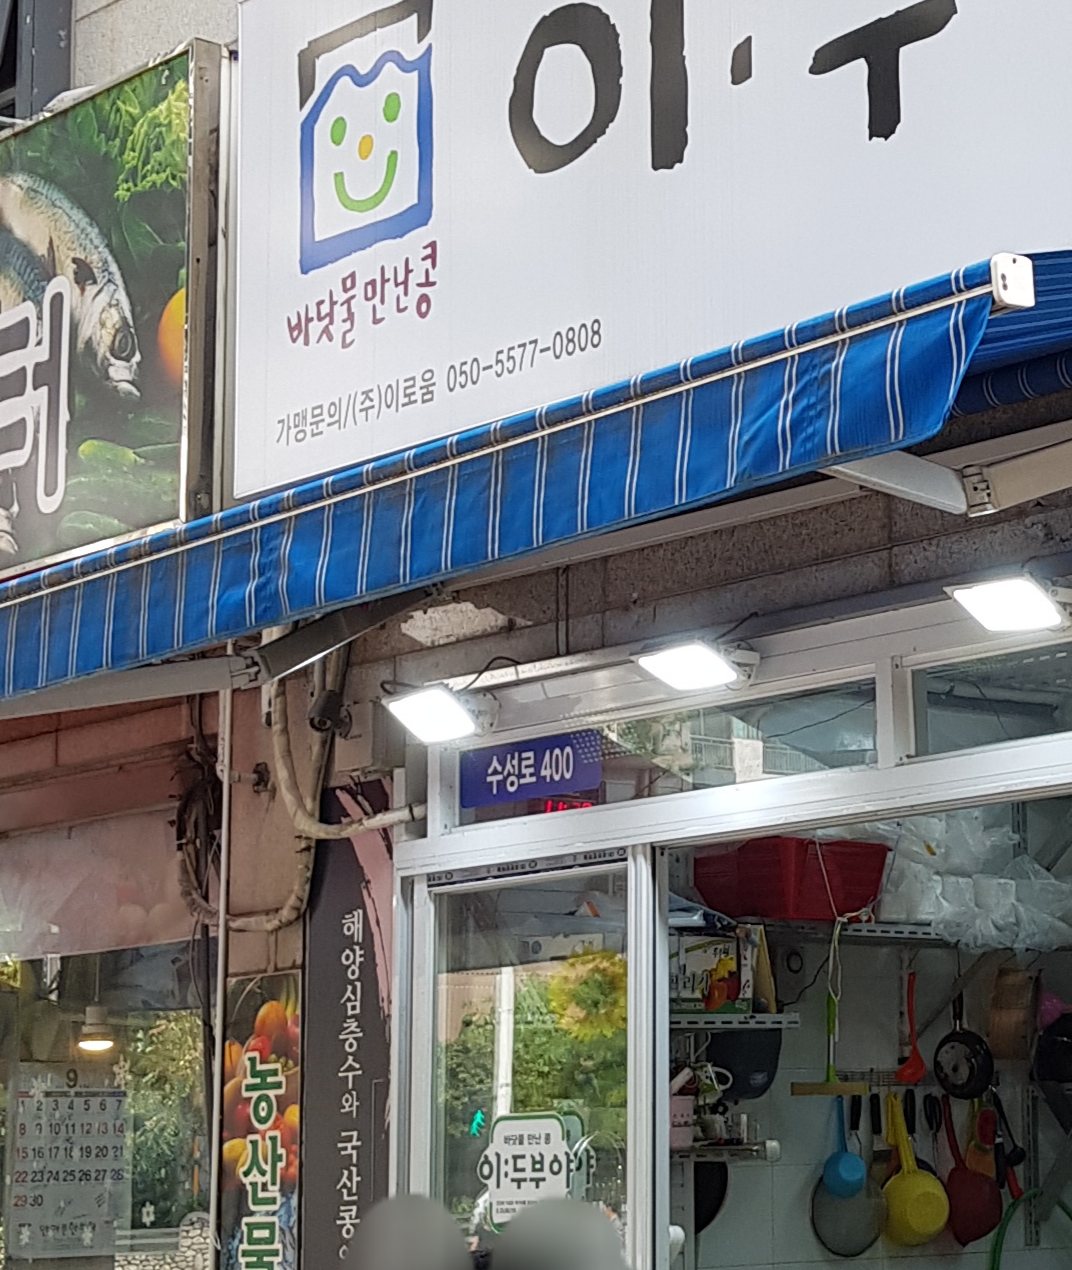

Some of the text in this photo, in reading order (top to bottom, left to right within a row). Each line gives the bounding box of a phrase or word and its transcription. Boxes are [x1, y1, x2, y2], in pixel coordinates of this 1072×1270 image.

[446, 318, 602, 393] 050-5577-0808
[486, 745, 574, 795] 수성로 400
[338, 909, 364, 1118] 해양심층수와
[66, 1068, 78, 1088] 9
